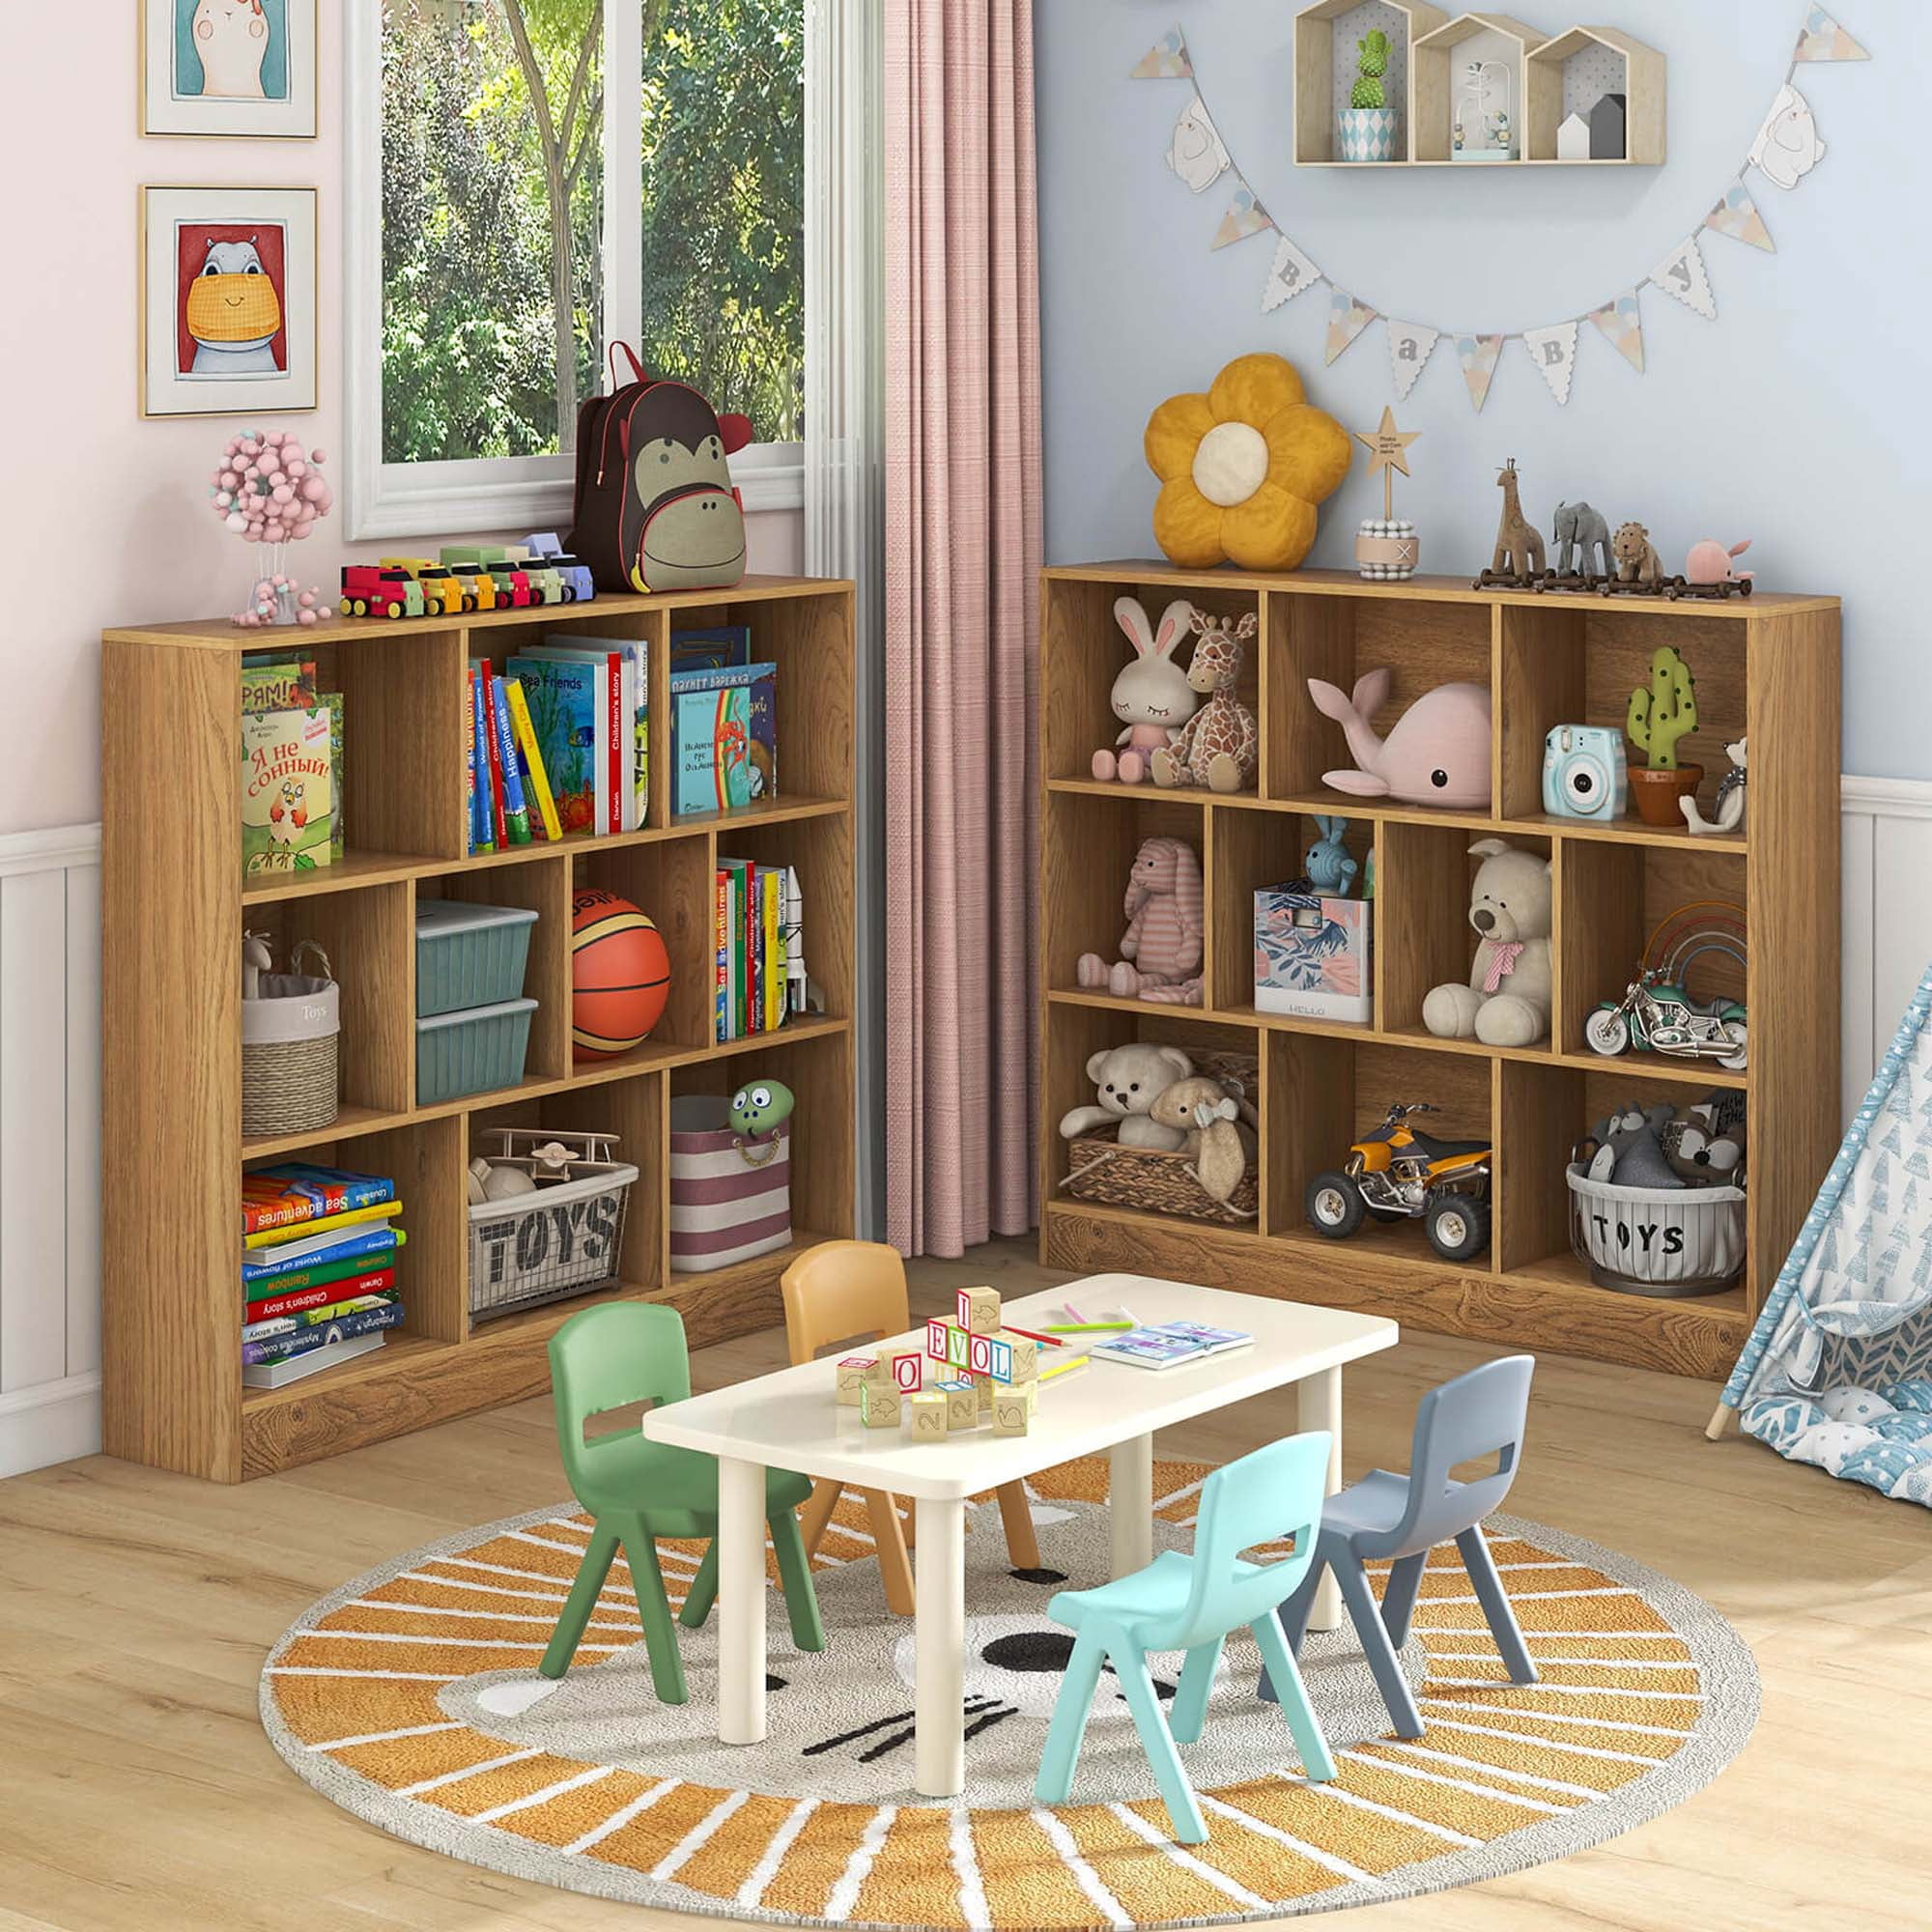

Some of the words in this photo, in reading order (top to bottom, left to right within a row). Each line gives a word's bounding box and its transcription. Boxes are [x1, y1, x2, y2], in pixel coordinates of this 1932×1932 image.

[520, 673, 540, 689] Sea
[543, 675, 582, 691] Friends
[497, 708, 519, 779] Happiness
[251, 746, 268, 774] Я
[272, 742, 298, 761] не
[247, 756, 330, 798] сонный!
[301, 1003, 328, 1021] Toys
[1289, 1004, 1325, 1015] HELLO
[326, 1196, 349, 1211] Sea
[258, 1200, 323, 1227] adventures
[479, 1196, 617, 1283] TOYS
[1593, 1215, 1684, 1255] TOYS
[267, 1273, 310, 1292] Rainbow
[359, 1277, 384, 1290] Darwin
[263, 1301, 284, 1315] story
[286, 1291, 327, 1309] Children's
[248, 1327, 272, 1339] story
